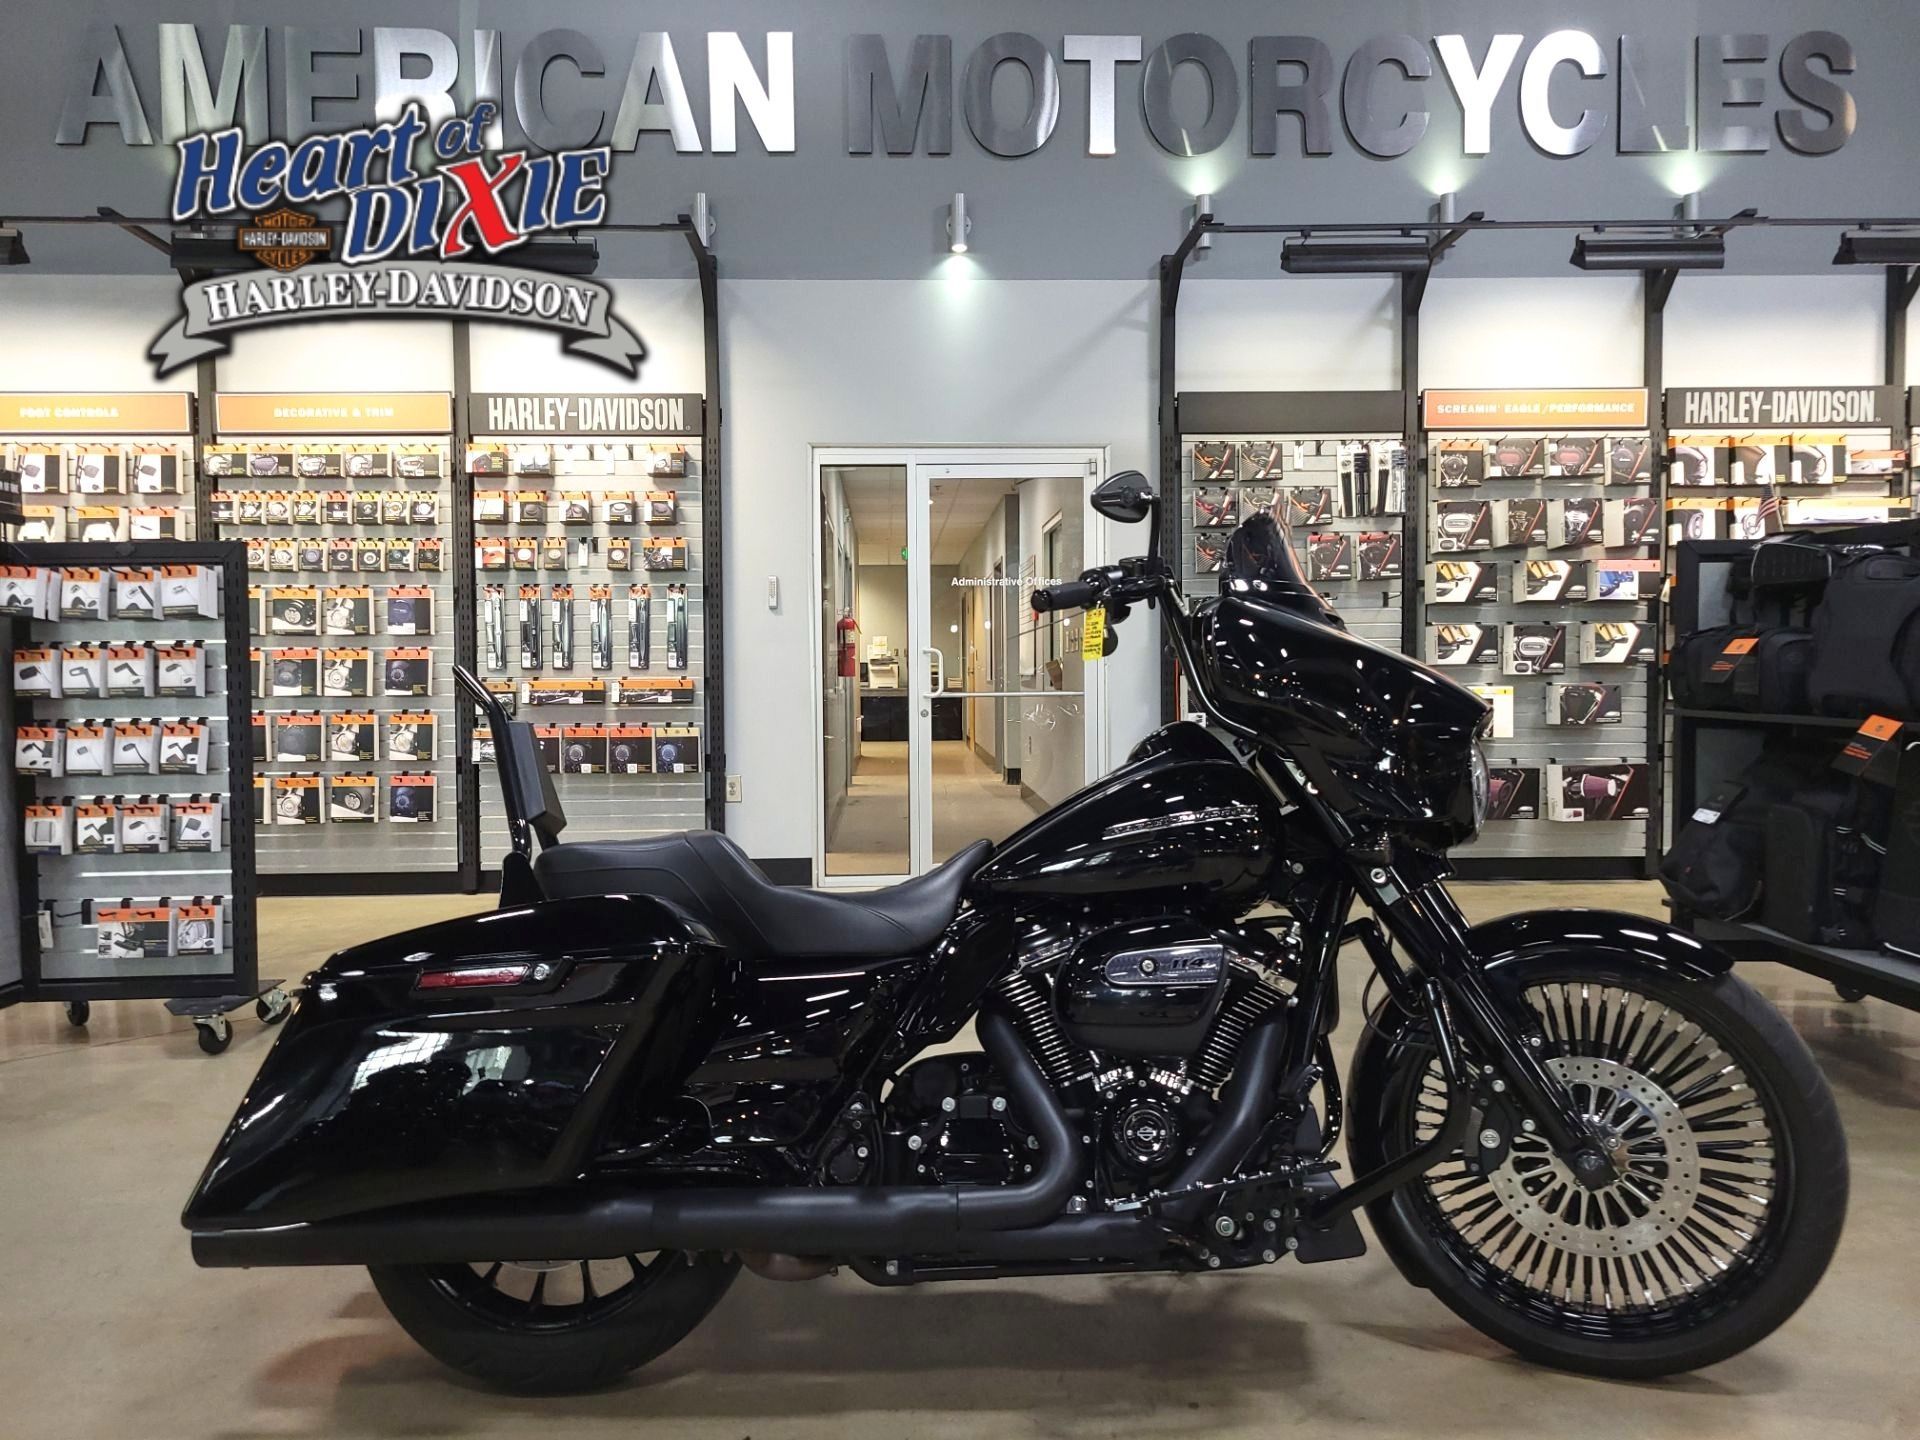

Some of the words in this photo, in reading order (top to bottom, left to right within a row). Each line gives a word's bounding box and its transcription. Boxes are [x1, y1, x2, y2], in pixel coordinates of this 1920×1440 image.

[55, 23, 796, 154] AMERICAN
[848, 30, 1858, 158] MOTORCYCLES
[273, 407, 349, 418] DECORATIVE
[488, 397, 684, 431] HARLEY-DAVIDSON
[1684, 390, 1876, 424] HARLEY-DAVIDSON
[951, 576, 1022, 586] Administrative
[1026, 576, 1063, 586] Offices
